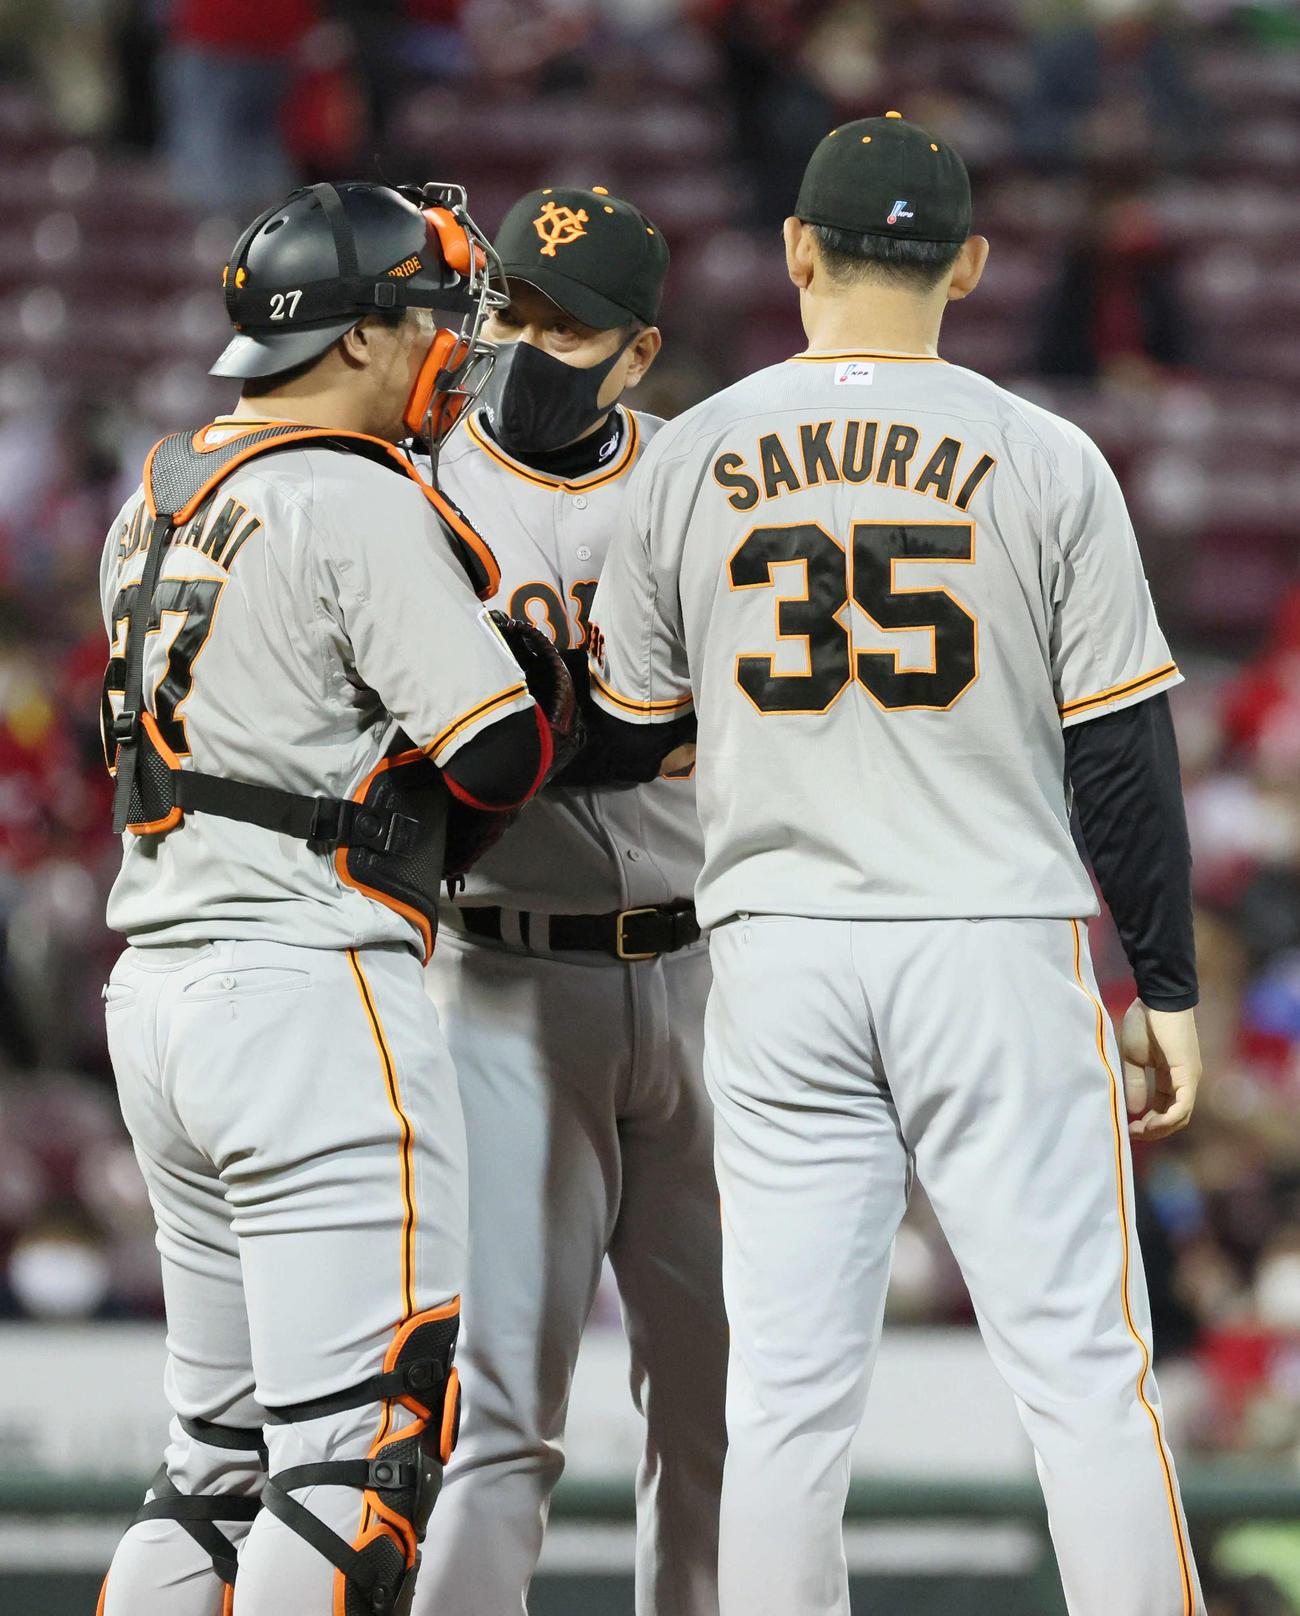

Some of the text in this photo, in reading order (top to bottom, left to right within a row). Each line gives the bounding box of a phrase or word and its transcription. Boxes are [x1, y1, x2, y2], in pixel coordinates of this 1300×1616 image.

[269, 289, 303, 320] 27
[713, 419, 996, 513] SAKURAI
[726, 519, 979, 716] 35
